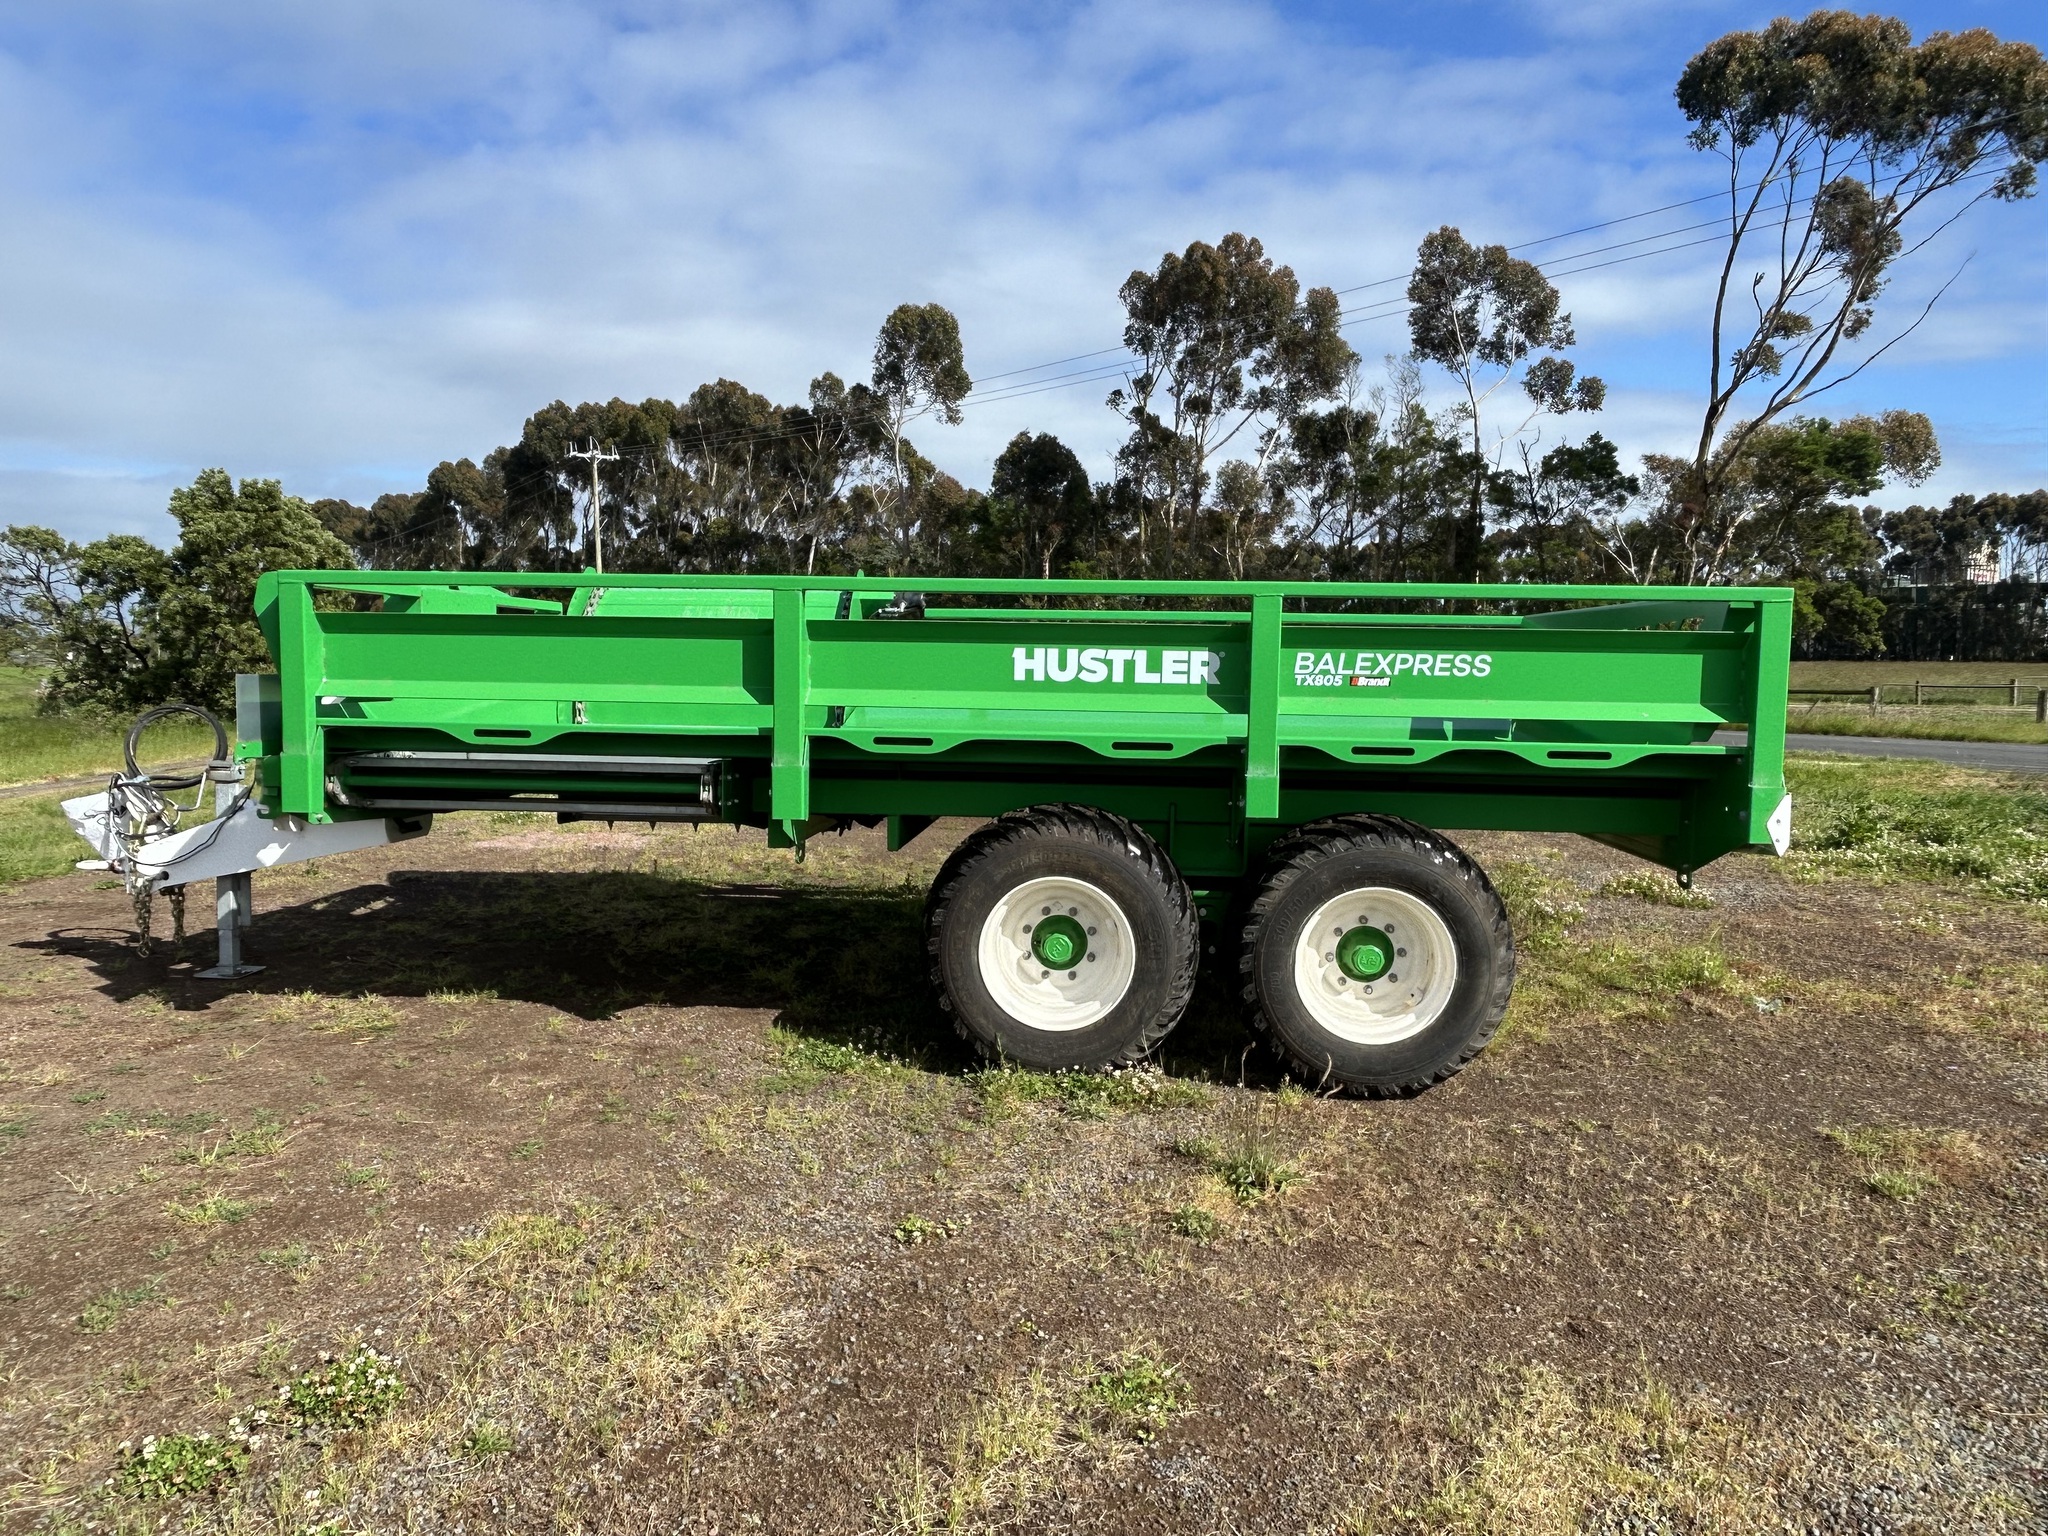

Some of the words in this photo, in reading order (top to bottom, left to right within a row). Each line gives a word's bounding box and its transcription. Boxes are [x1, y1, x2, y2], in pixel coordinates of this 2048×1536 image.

[1012, 647, 1220, 684] HUSTLER
[1294, 652, 1492, 677] BALEXPRESS
[1294, 674, 1343, 686] TX805
